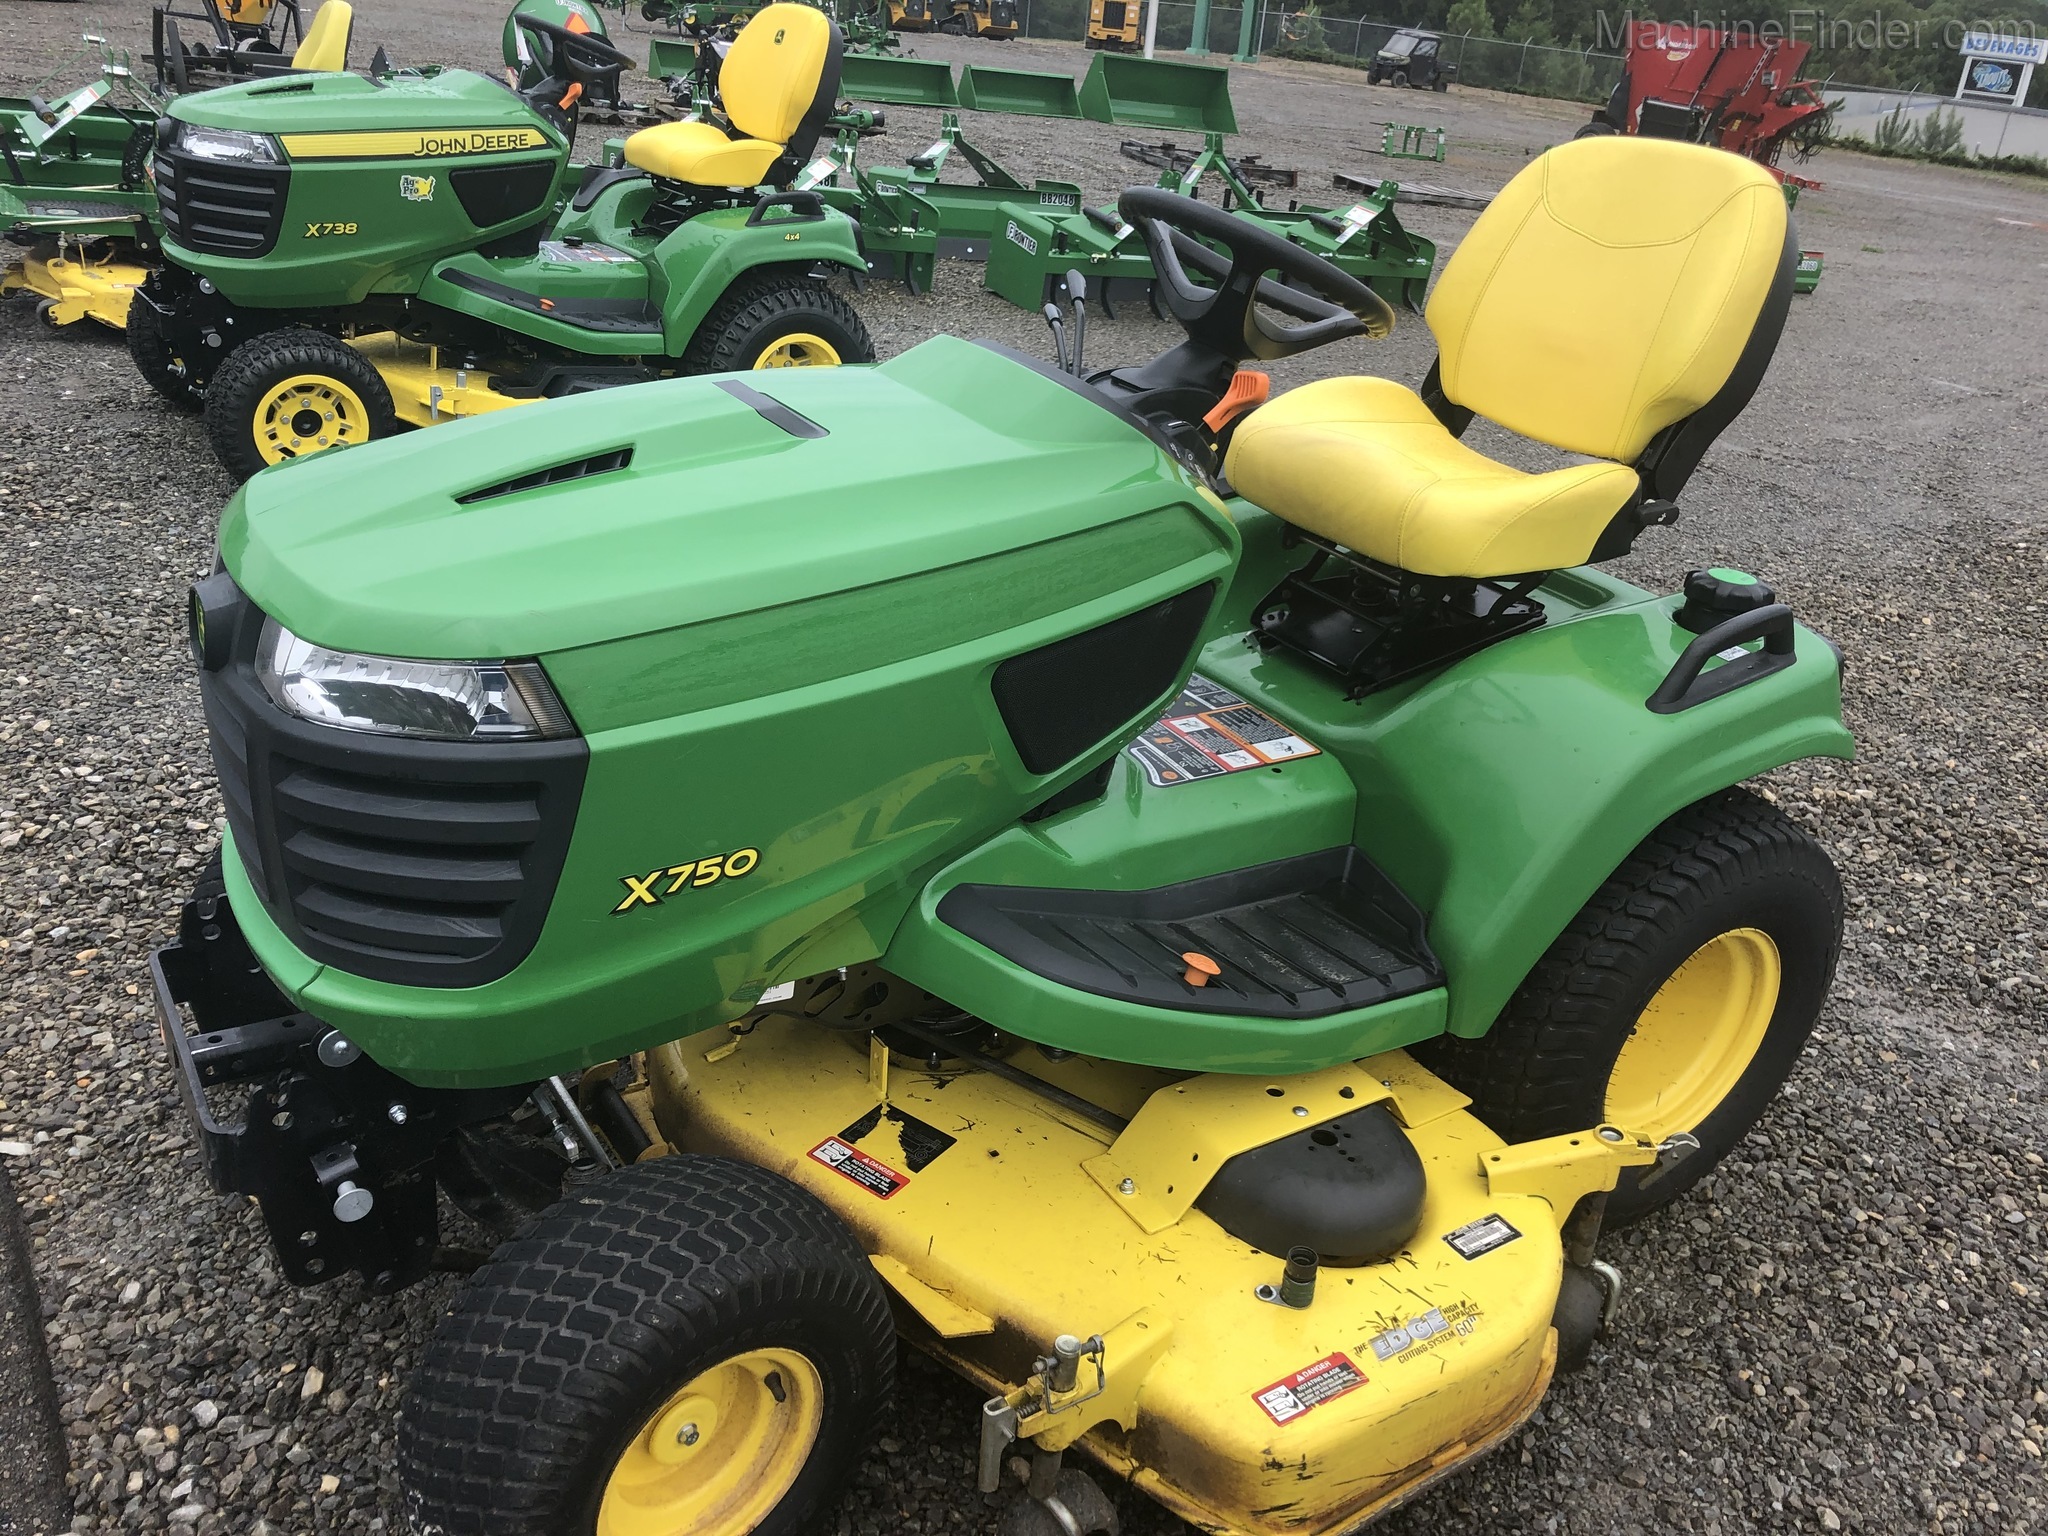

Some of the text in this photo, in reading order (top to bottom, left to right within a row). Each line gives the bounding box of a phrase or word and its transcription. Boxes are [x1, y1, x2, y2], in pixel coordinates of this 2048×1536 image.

[1965, 38, 2040, 57] BEVERAGES
[414, 133, 529, 155] JOHN DEERE
[403, 186, 419, 195] Pro
[1040, 193, 1075, 206] BB2048
[303, 222, 358, 238] X738
[784, 233, 801, 241] 4x4
[1006, 220, 1037, 255] FRONTIER
[611, 847, 762, 915] X750
[851, 1159, 891, 1183] ROTATING BLADE
[869, 1160, 896, 1178] DANGER
[1441, 1302, 1459, 1315] HIGH
[1446, 1302, 1479, 1324] CAPACITY
[1353, 1306, 1450, 1362] THE EDGE
[1397, 1315, 1478, 1364] CUTTING SYSTEM 60"
[1301, 1360, 1332, 1378] DANGER
[1296, 1367, 1342, 1392] ROTATING BLADE
